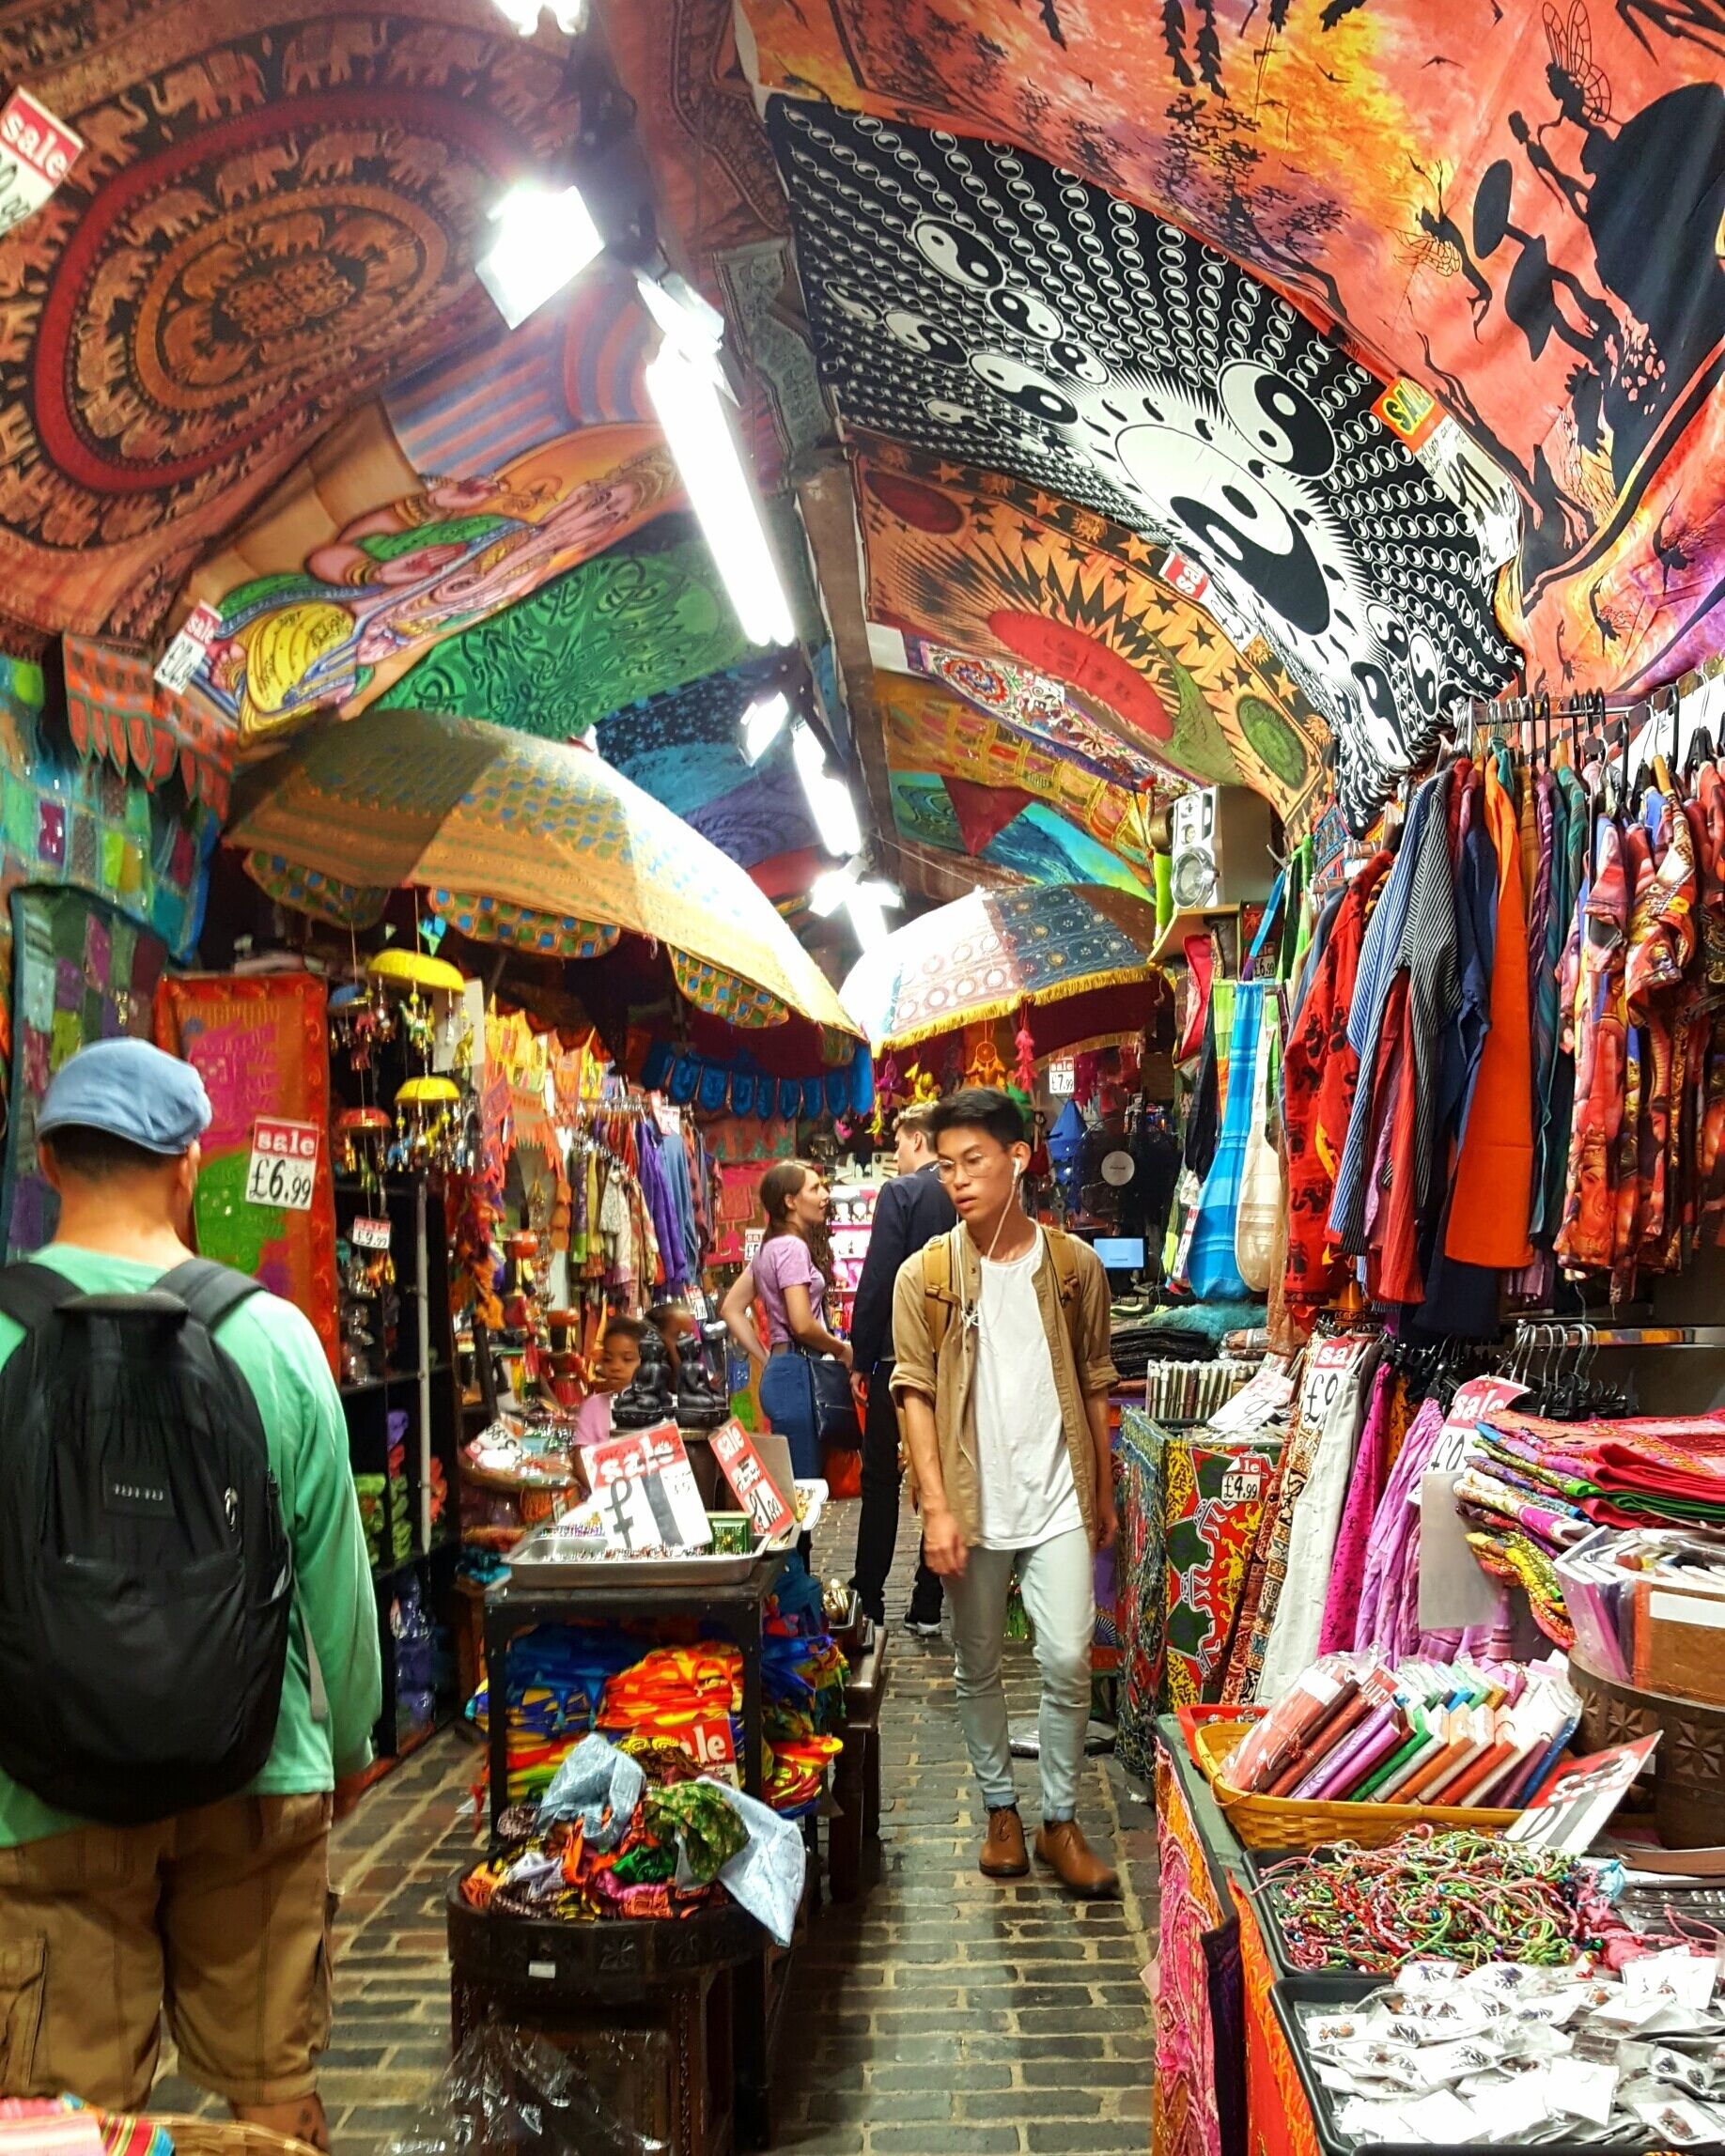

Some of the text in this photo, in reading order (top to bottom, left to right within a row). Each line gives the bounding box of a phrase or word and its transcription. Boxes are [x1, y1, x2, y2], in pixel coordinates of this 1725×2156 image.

[2, 112, 68, 178] sale
[1051, 1061, 1073, 1071] sale
[1051, 1074, 1073, 1091] £7.99
[256, 1128, 316, 1156] sale
[249, 1159, 312, 1206] £6.99
[598, 1435, 675, 1486] sale
[715, 1424, 745, 1463] sale
[1242, 1459, 1260, 1473] le
[1223, 1475, 1258, 1499] £4.99
[603, 1475, 686, 1549] £1
[679, 1723, 727, 1764] le
